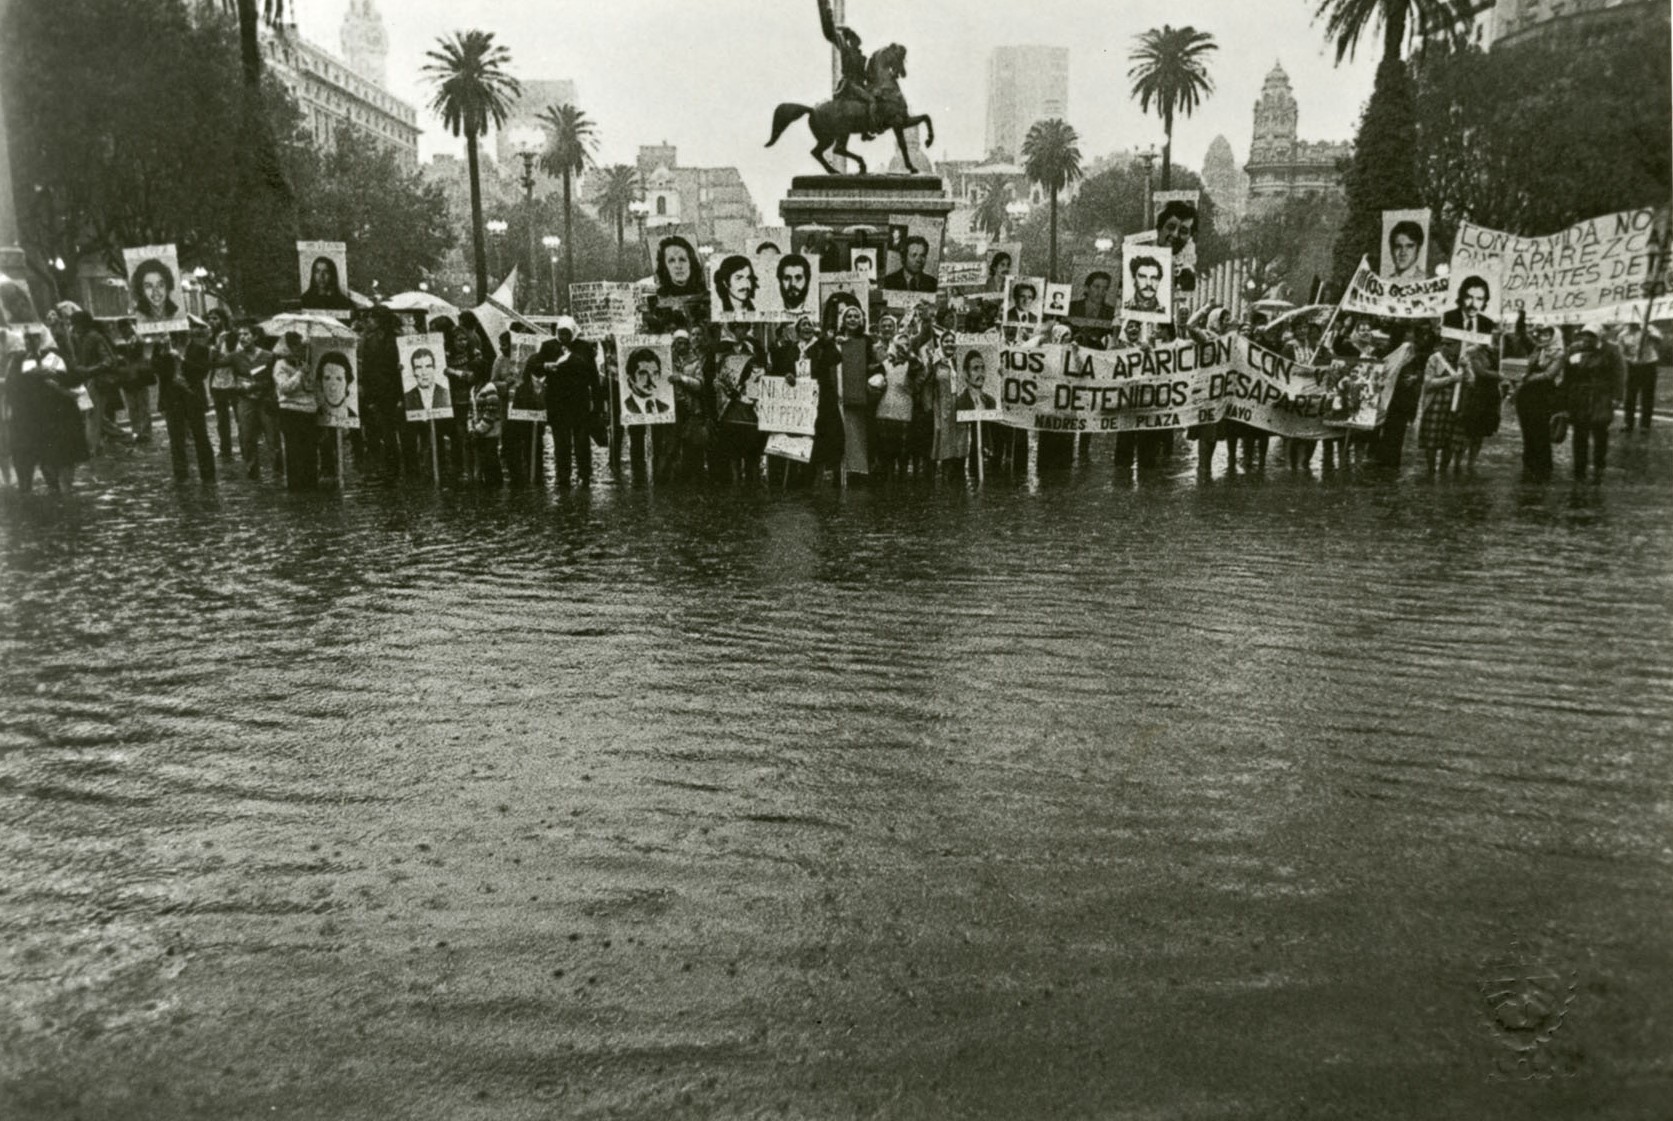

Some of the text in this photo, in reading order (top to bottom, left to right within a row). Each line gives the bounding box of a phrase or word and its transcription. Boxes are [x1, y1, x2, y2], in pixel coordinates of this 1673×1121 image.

[1503, 264, 1601, 291] DIANTES
[1063, 351, 1096, 379] LA
[1112, 336, 1232, 380] APARICION
[1247, 343, 1294, 385] CON
[1034, 414, 1087, 431] MADRES
[1101, 416, 1118, 430] DE
[1135, 413, 1181, 429] PLAZA
[1199, 408, 1215, 422] DE
